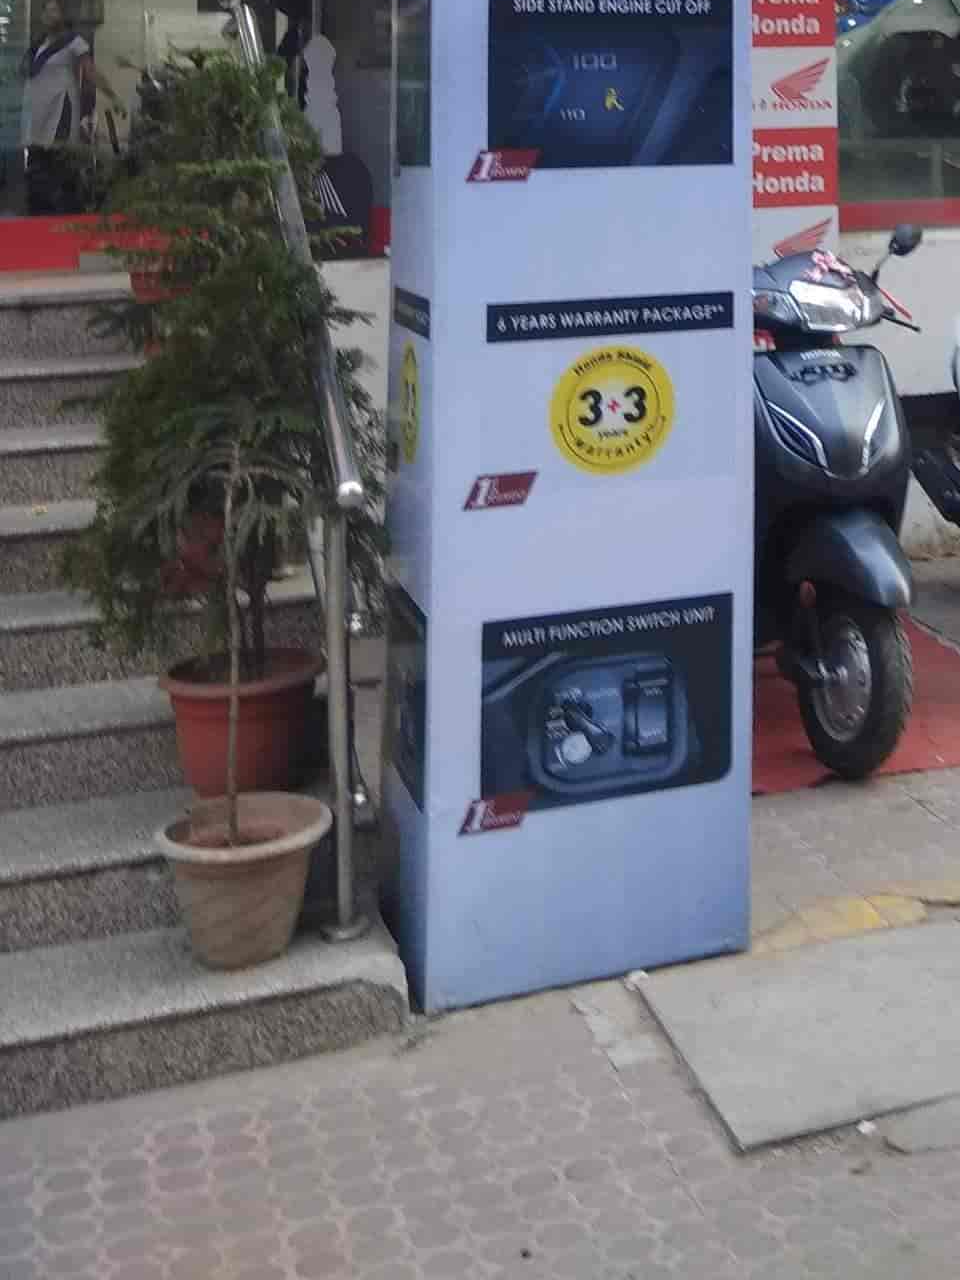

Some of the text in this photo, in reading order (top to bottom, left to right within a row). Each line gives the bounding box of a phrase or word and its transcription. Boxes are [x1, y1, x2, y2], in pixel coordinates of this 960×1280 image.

[655, 0, 682, 15] CUT
[685, 0, 712, 15] OFF
[511, 312, 556, 332] YEARS
[559, 308, 640, 329] WARRANTY
[503, 605, 717, 649] MULTI FUNCTION SWITCH UNIT
